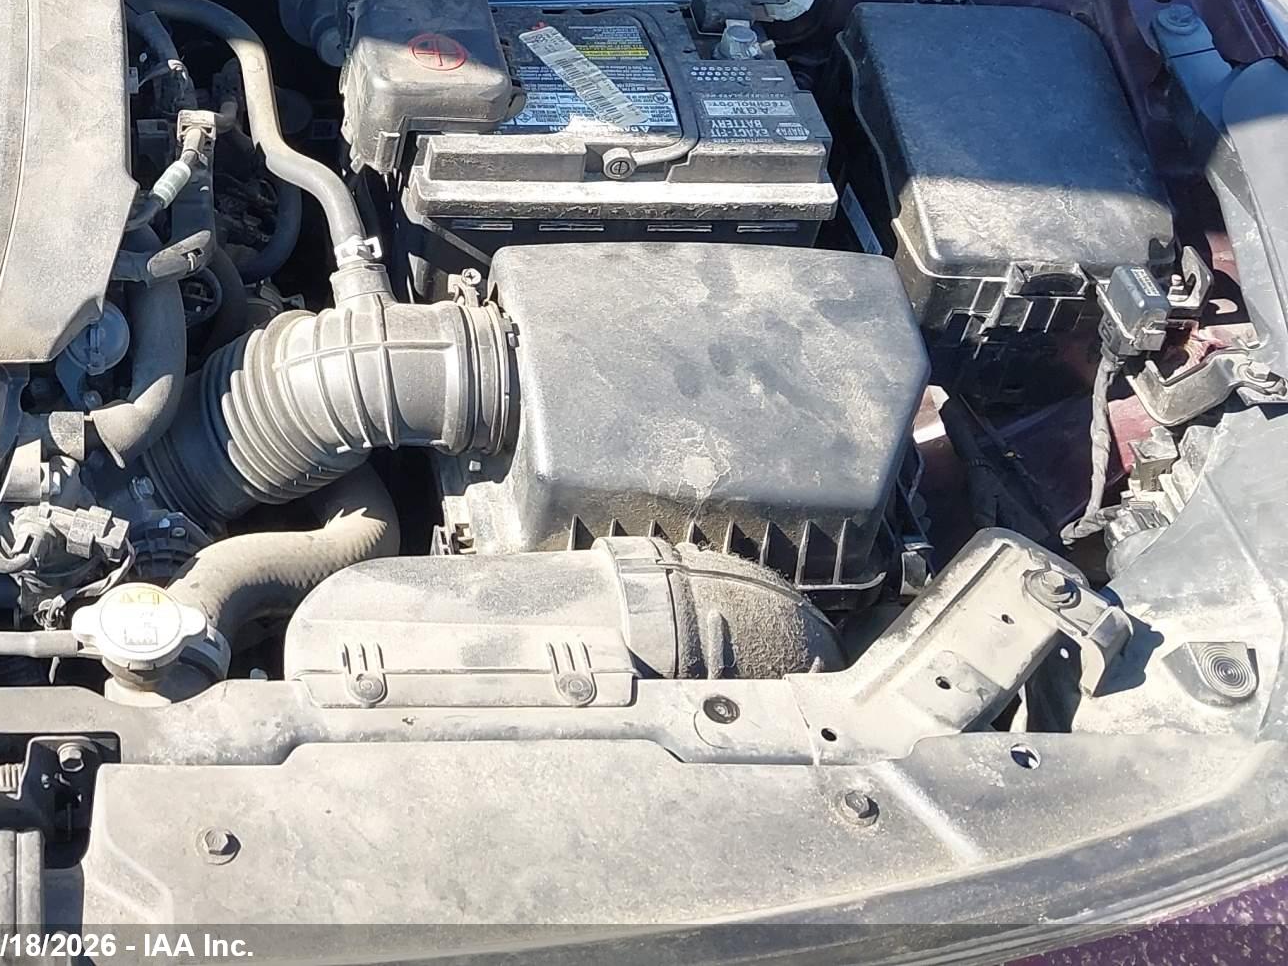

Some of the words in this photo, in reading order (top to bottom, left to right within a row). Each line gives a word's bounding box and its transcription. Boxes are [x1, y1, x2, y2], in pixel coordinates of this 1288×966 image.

[732, 107, 769, 115] AGM
[711, 119, 763, 128] BATTERY
[711, 128, 771, 138] EXACT-FIT
[781, 127, 807, 136] NAPA
